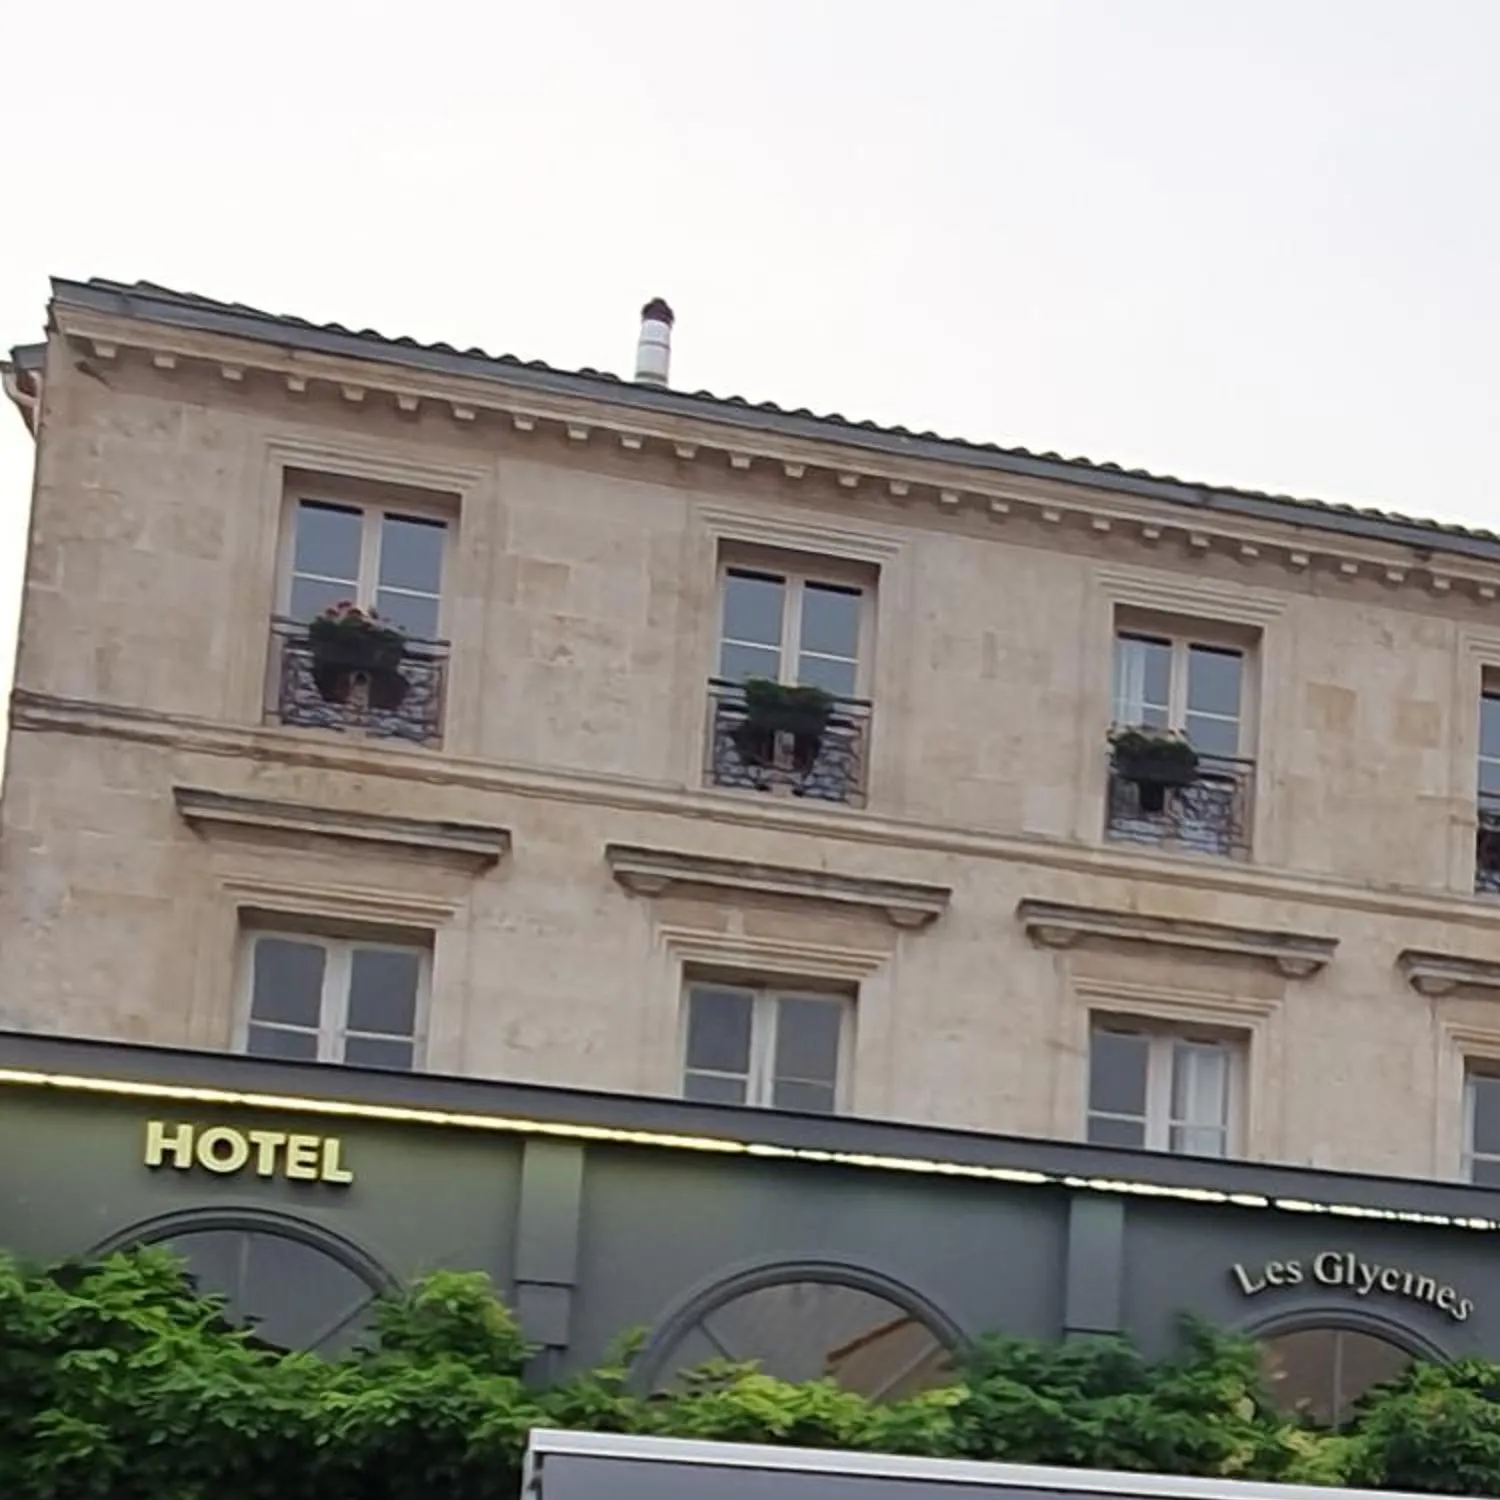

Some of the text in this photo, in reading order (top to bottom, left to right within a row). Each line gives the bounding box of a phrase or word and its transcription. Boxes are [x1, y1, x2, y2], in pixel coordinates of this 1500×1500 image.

[144, 1120, 354, 1184] HOTEL
[1232, 1251, 1475, 1321] Les Glycines
